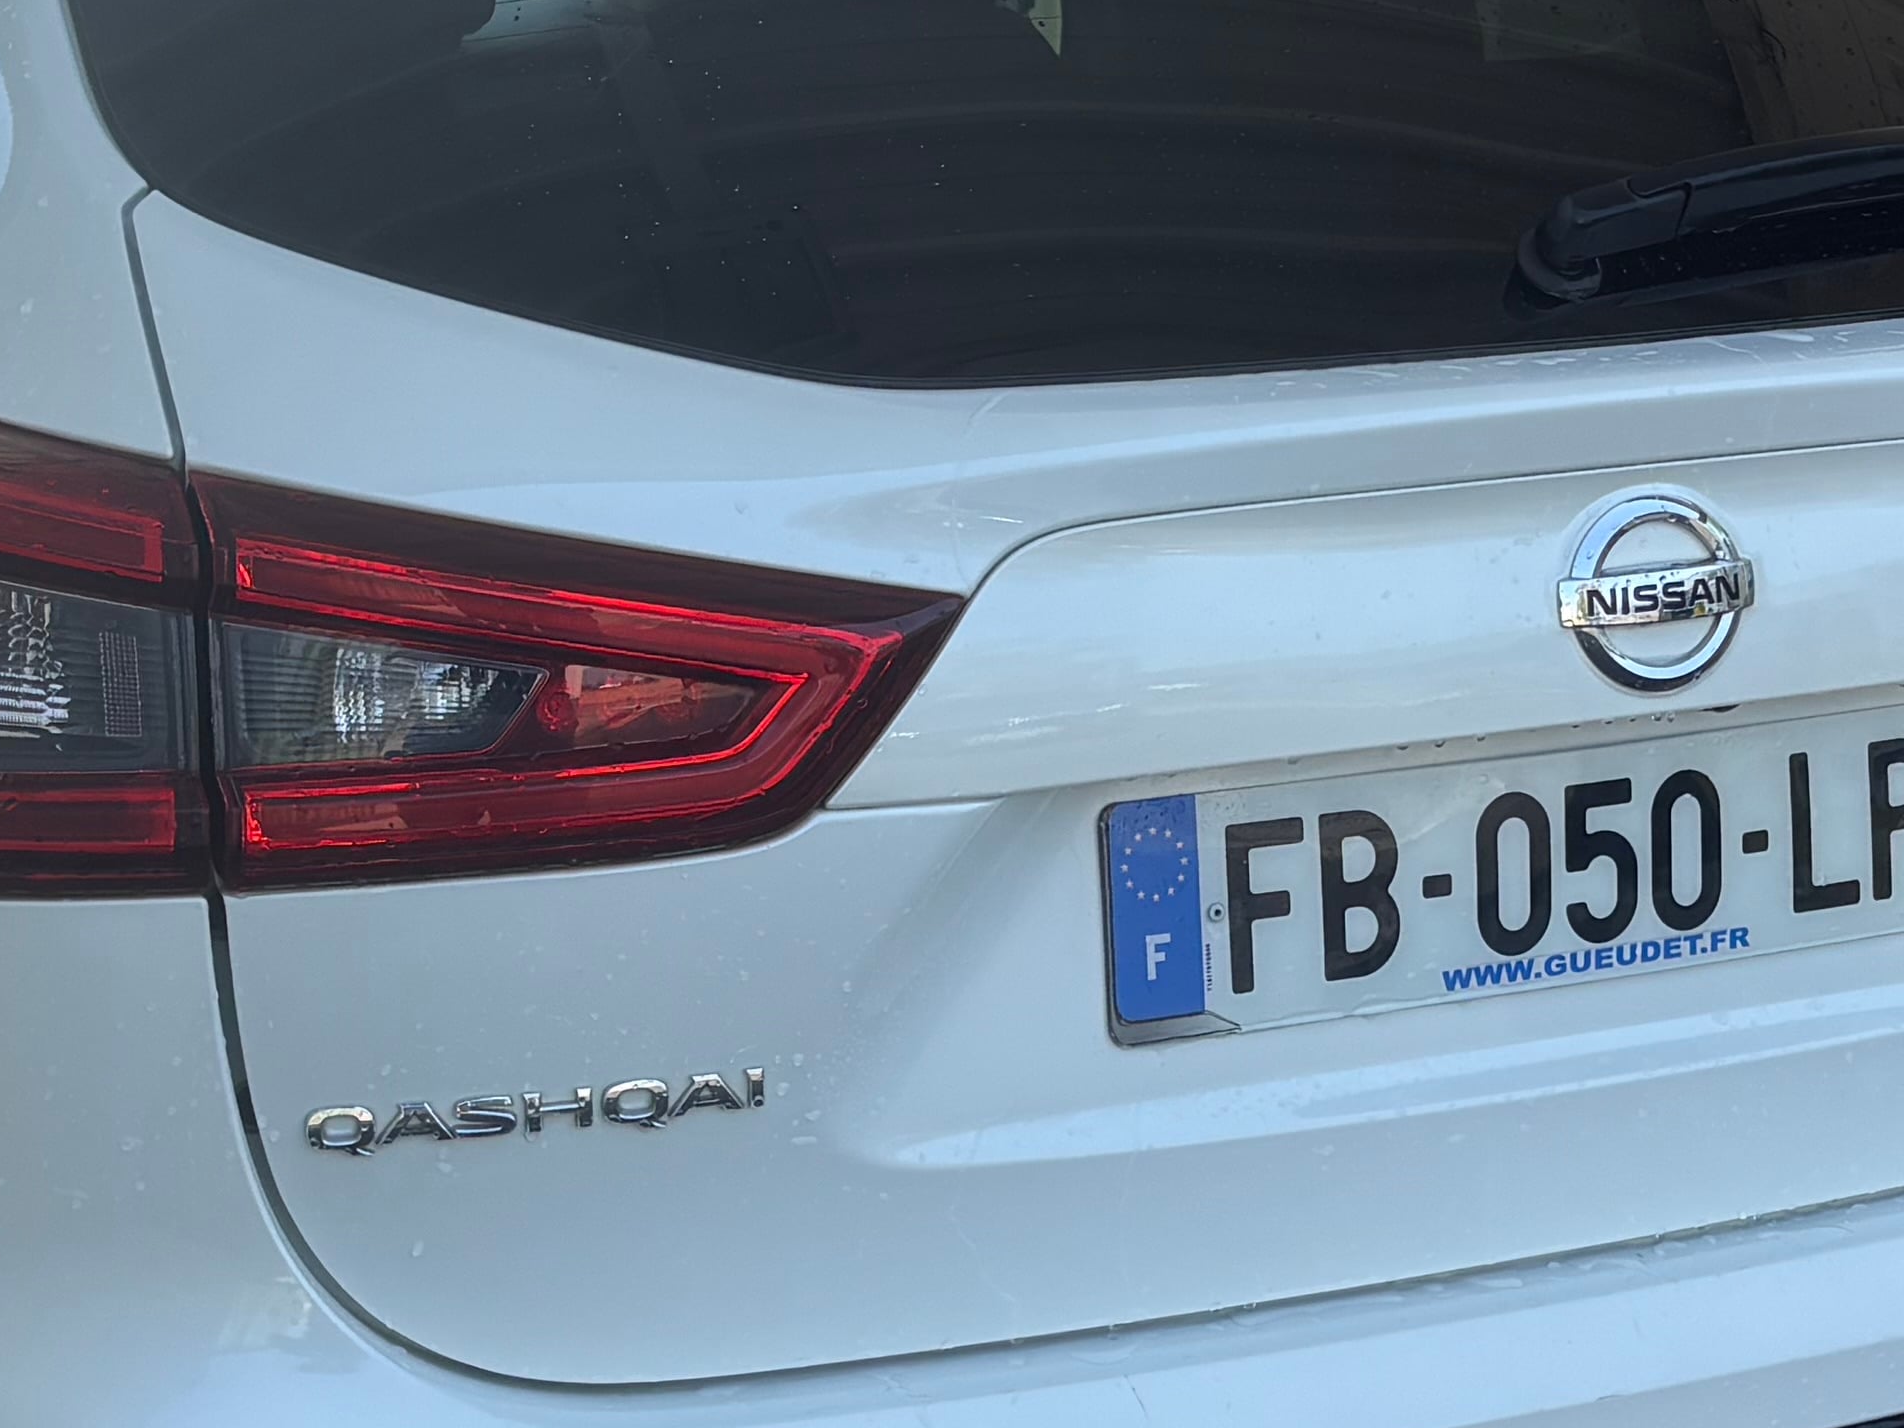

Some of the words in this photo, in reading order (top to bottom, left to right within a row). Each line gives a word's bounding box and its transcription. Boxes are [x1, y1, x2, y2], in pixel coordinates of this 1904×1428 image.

[1586, 573, 1740, 617] NISSAN
[1145, 933, 1171, 981] F
[1442, 926, 1750, 992] WWW.GUEUDET.FR
[305, 1066, 766, 1156] QASHQAI
